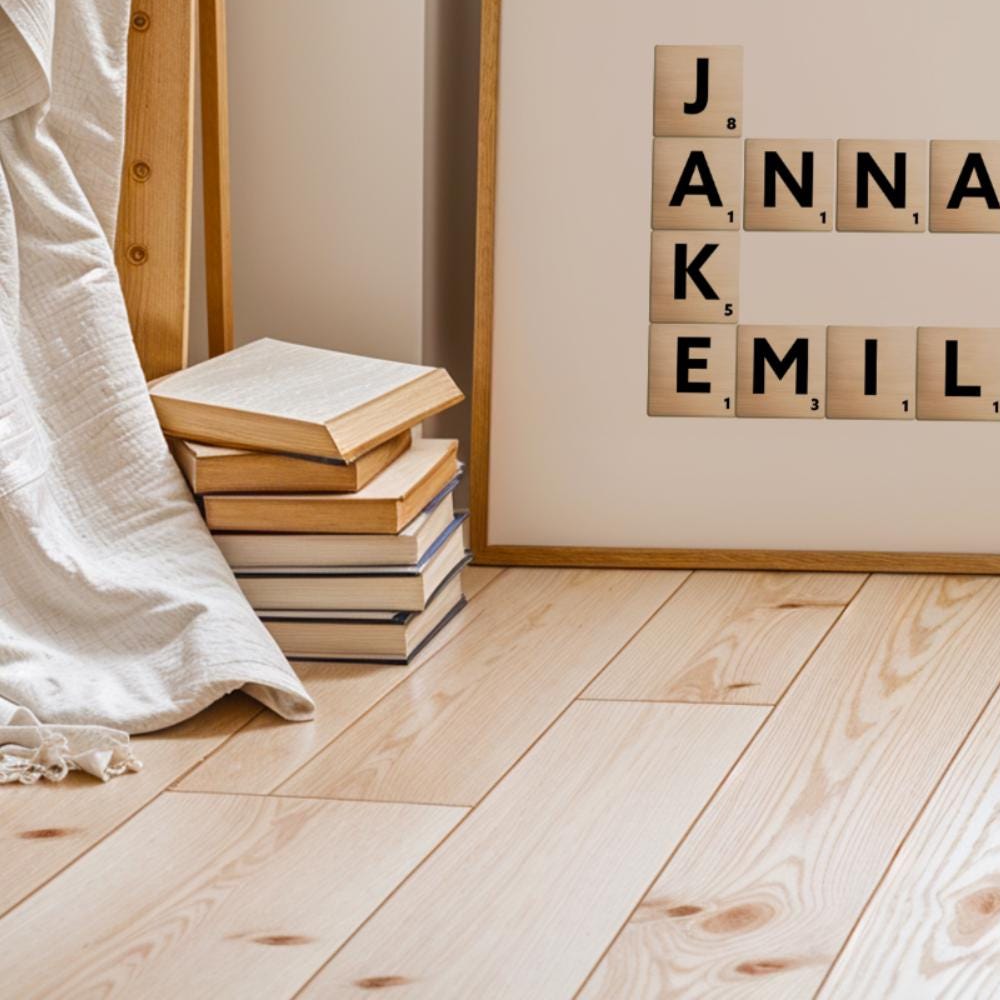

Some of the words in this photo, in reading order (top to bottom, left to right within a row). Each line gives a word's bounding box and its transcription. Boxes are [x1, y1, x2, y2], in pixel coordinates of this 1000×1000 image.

[726, 117, 737, 130] 8
[727, 210, 735, 223] 1
[819, 211, 827, 224] 1
[911, 212, 919, 225] 1
[668, 57, 723, 394] JAKE
[724, 303, 733, 317] 5
[723, 397, 731, 410] 1
[810, 398, 819, 411] 3
[901, 400, 909, 413] 1
[991, 401, 999, 414] 1
